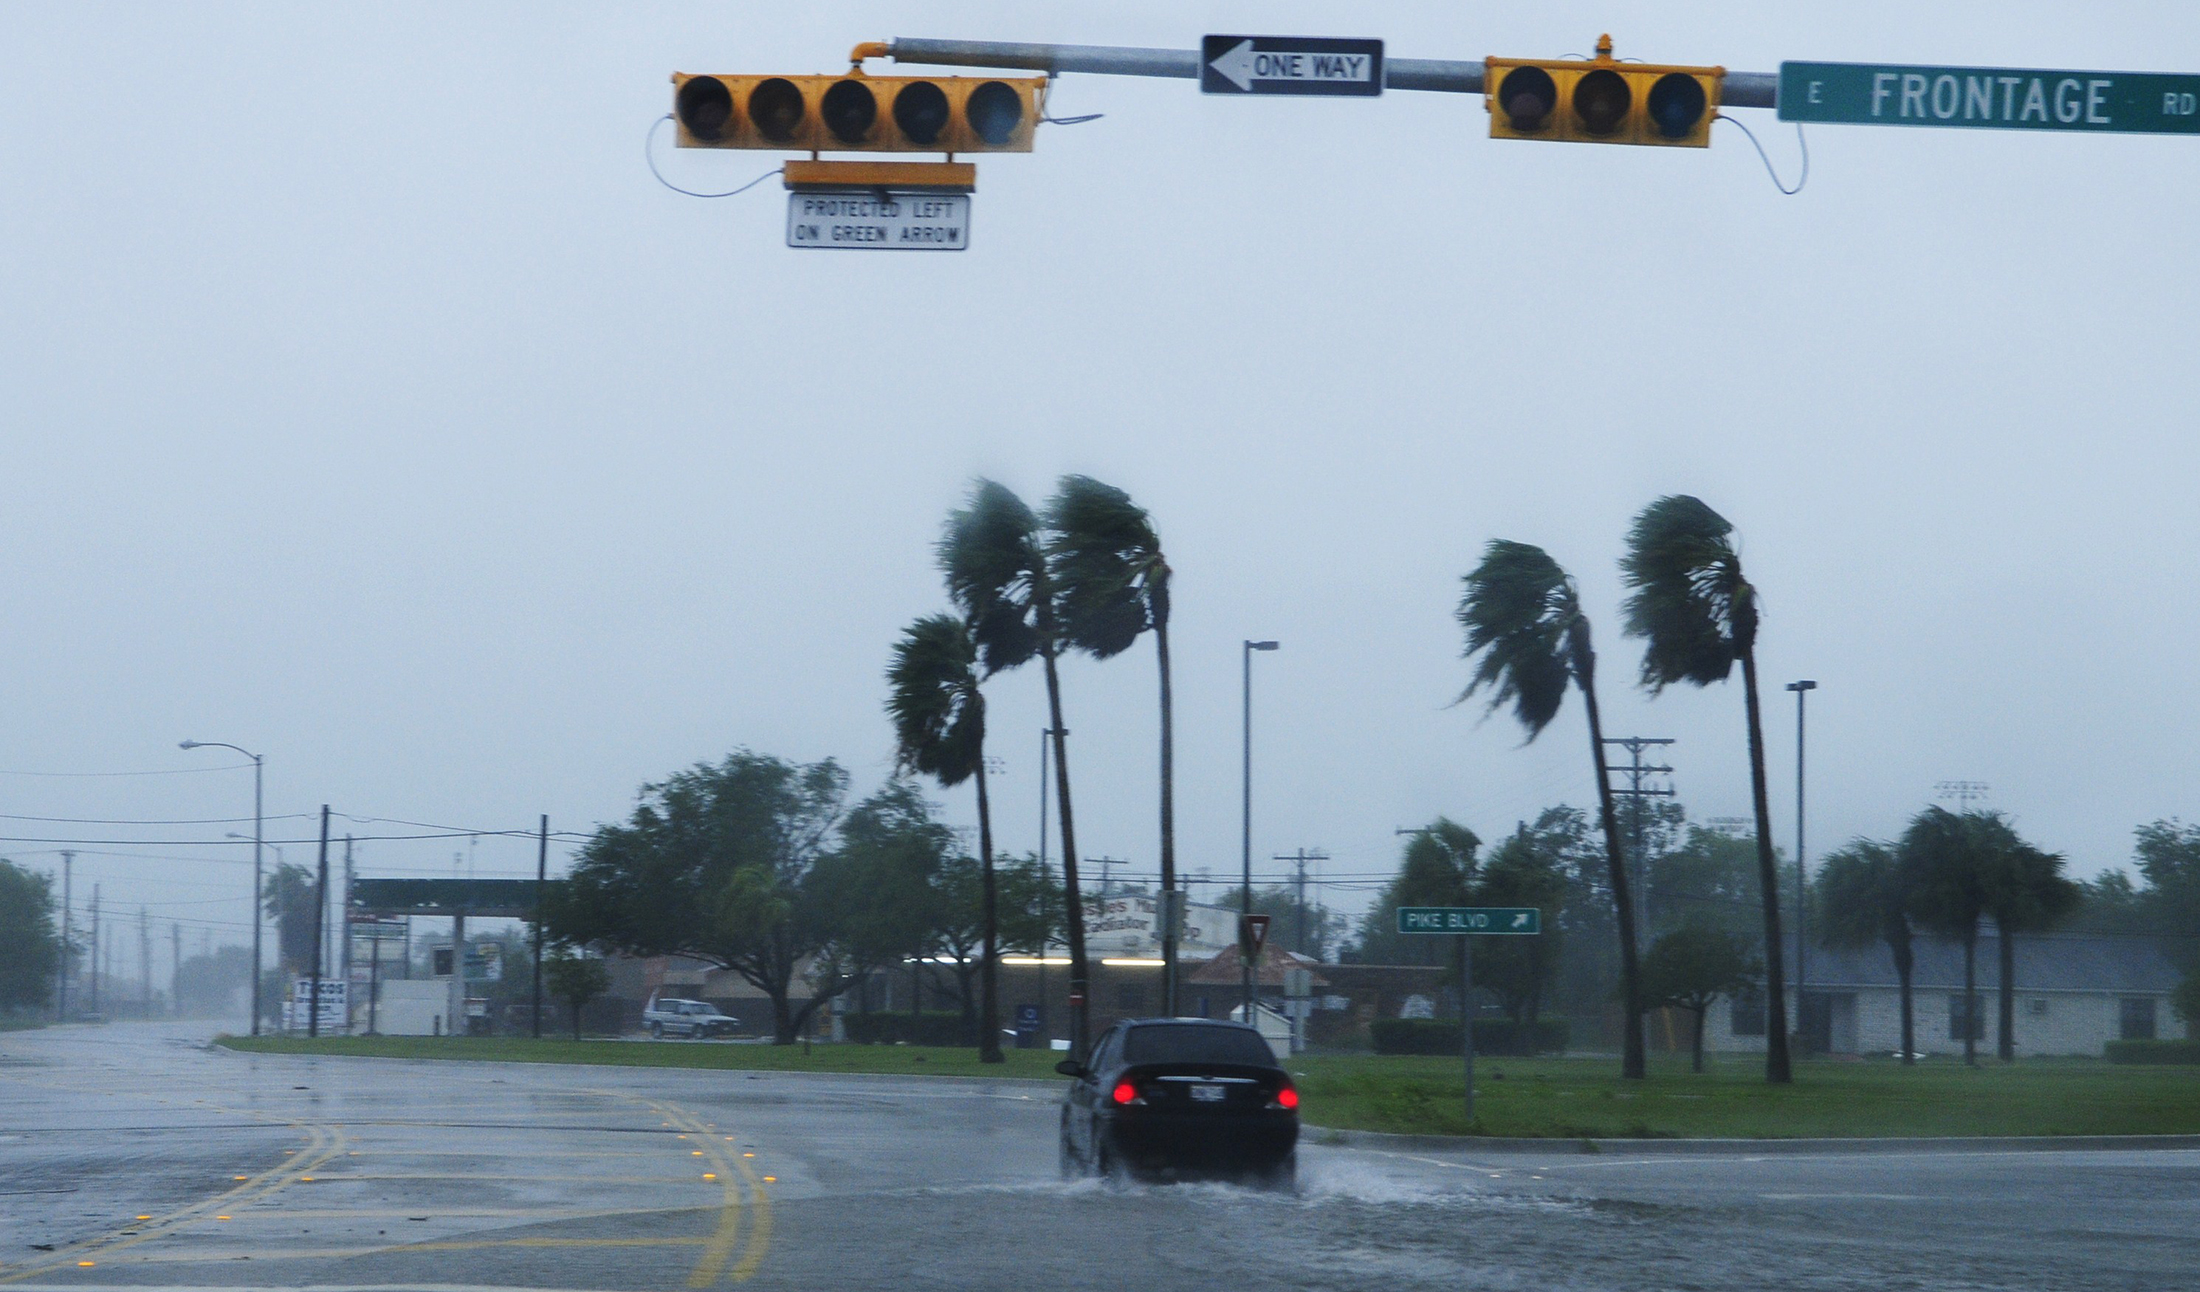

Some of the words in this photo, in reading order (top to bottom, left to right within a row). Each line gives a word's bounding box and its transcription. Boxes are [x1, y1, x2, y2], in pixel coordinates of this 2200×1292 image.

[1254, 54, 1304, 78] ONE
[1311, 56, 1364, 79] WAY
[1807, 80, 1824, 104] E
[1869, 72, 2114, 125] FRONTAGE
[2162, 92, 2197, 116] RD
[804, 199, 900, 218] PROTECTED
[913, 202, 954, 218] LEFT
[795, 224, 819, 240] ON
[832, 225, 888, 242] GREEN
[900, 226, 960, 243] ARROW
[1406, 912, 1442, 928] PIKE
[1447, 913, 1490, 928] BLVD
[298, 981, 344, 995] TCOS
